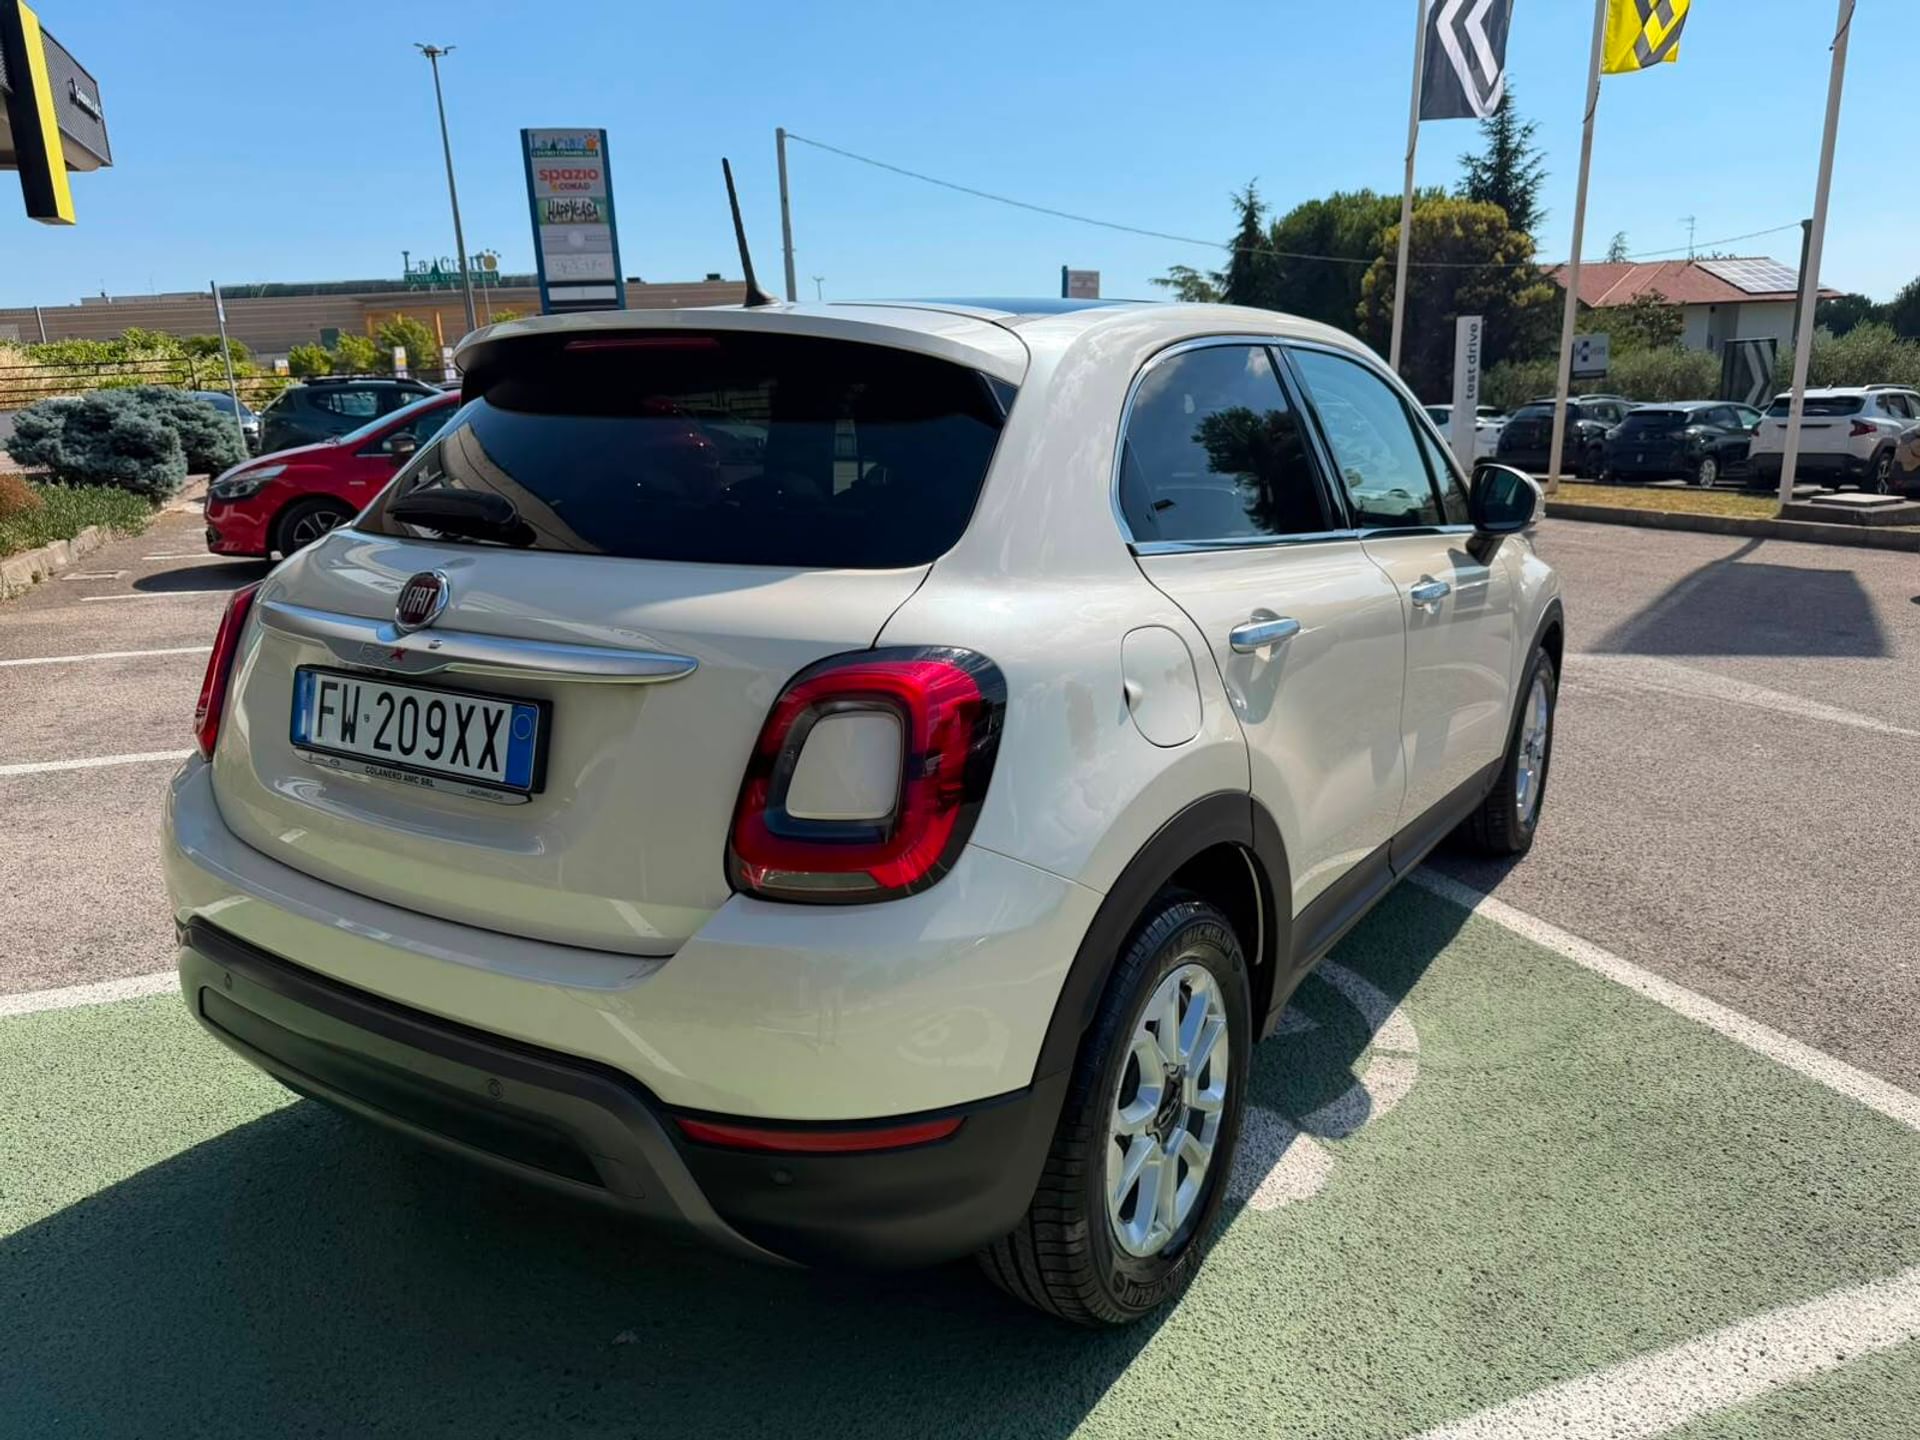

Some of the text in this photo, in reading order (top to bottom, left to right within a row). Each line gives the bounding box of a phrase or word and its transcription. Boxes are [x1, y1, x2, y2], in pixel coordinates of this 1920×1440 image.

[538, 168, 599, 184] spazio
[1466, 323, 1478, 400] test drive
[402, 585, 437, 614] FIAT
[316, 680, 505, 773] FW 209XX
[365, 765, 402, 780] COLANERO
[420, 777, 435, 788] SRL
